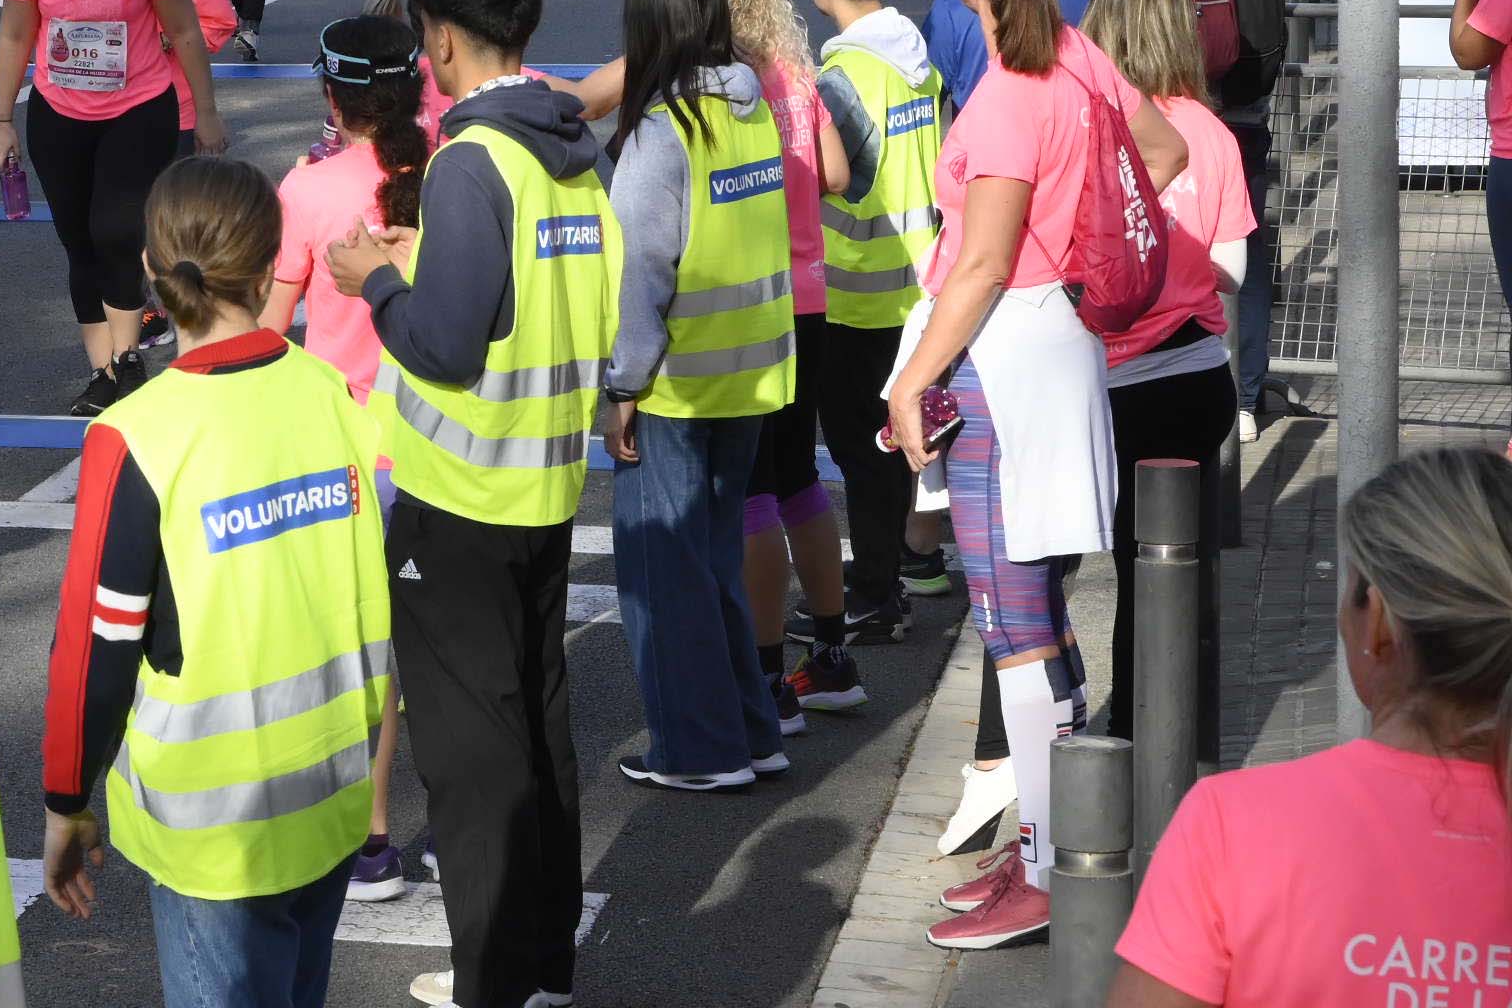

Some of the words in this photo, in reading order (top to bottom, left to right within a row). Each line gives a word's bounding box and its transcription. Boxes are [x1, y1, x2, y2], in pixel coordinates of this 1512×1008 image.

[72, 48, 98, 59] 016
[712, 164, 783, 195] VOLUNTARIS
[207, 482, 349, 539] VOLUNTARIS
[1343, 934, 1512, 988] CARRE
